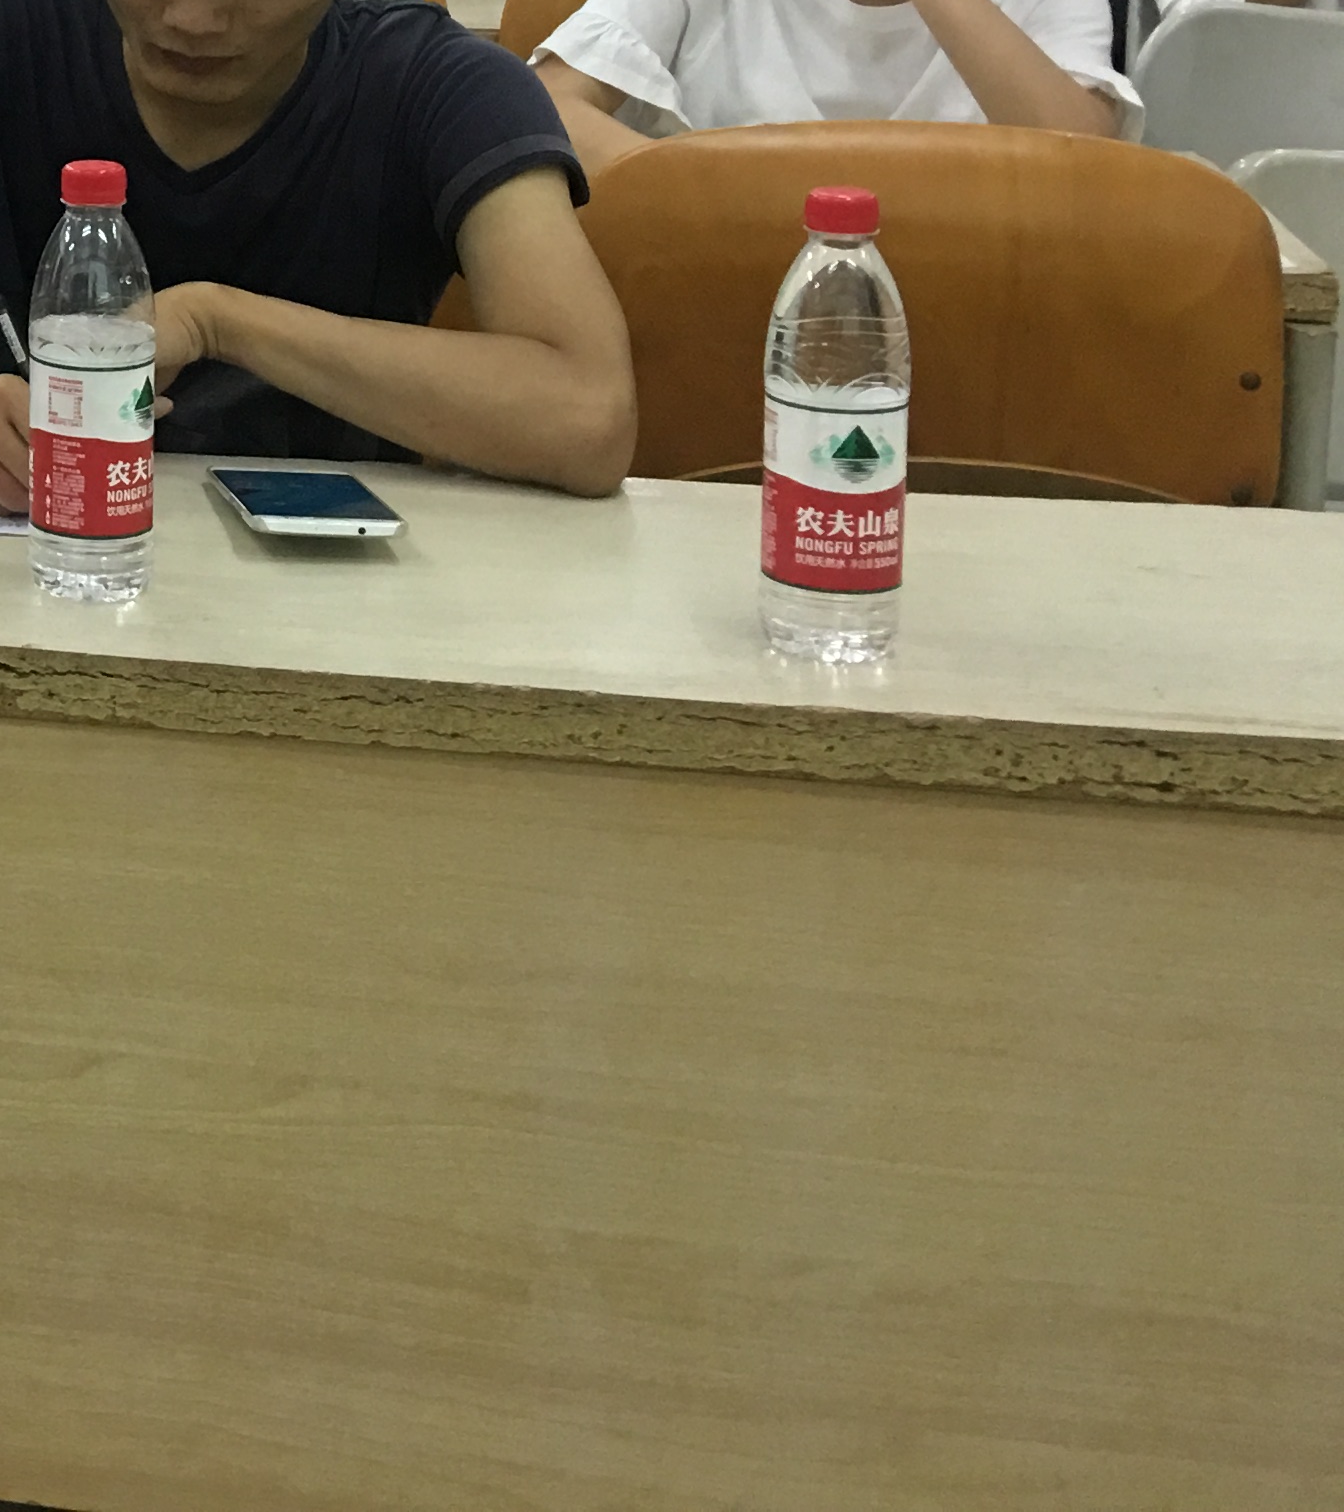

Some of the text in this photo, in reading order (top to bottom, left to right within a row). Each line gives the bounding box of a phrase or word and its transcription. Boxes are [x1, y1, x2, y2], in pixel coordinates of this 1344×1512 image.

[107, 487, 147, 503] NONGFU
[796, 506, 900, 538] 农夫山泉
[795, 536, 899, 555] NONGFU SPRING
